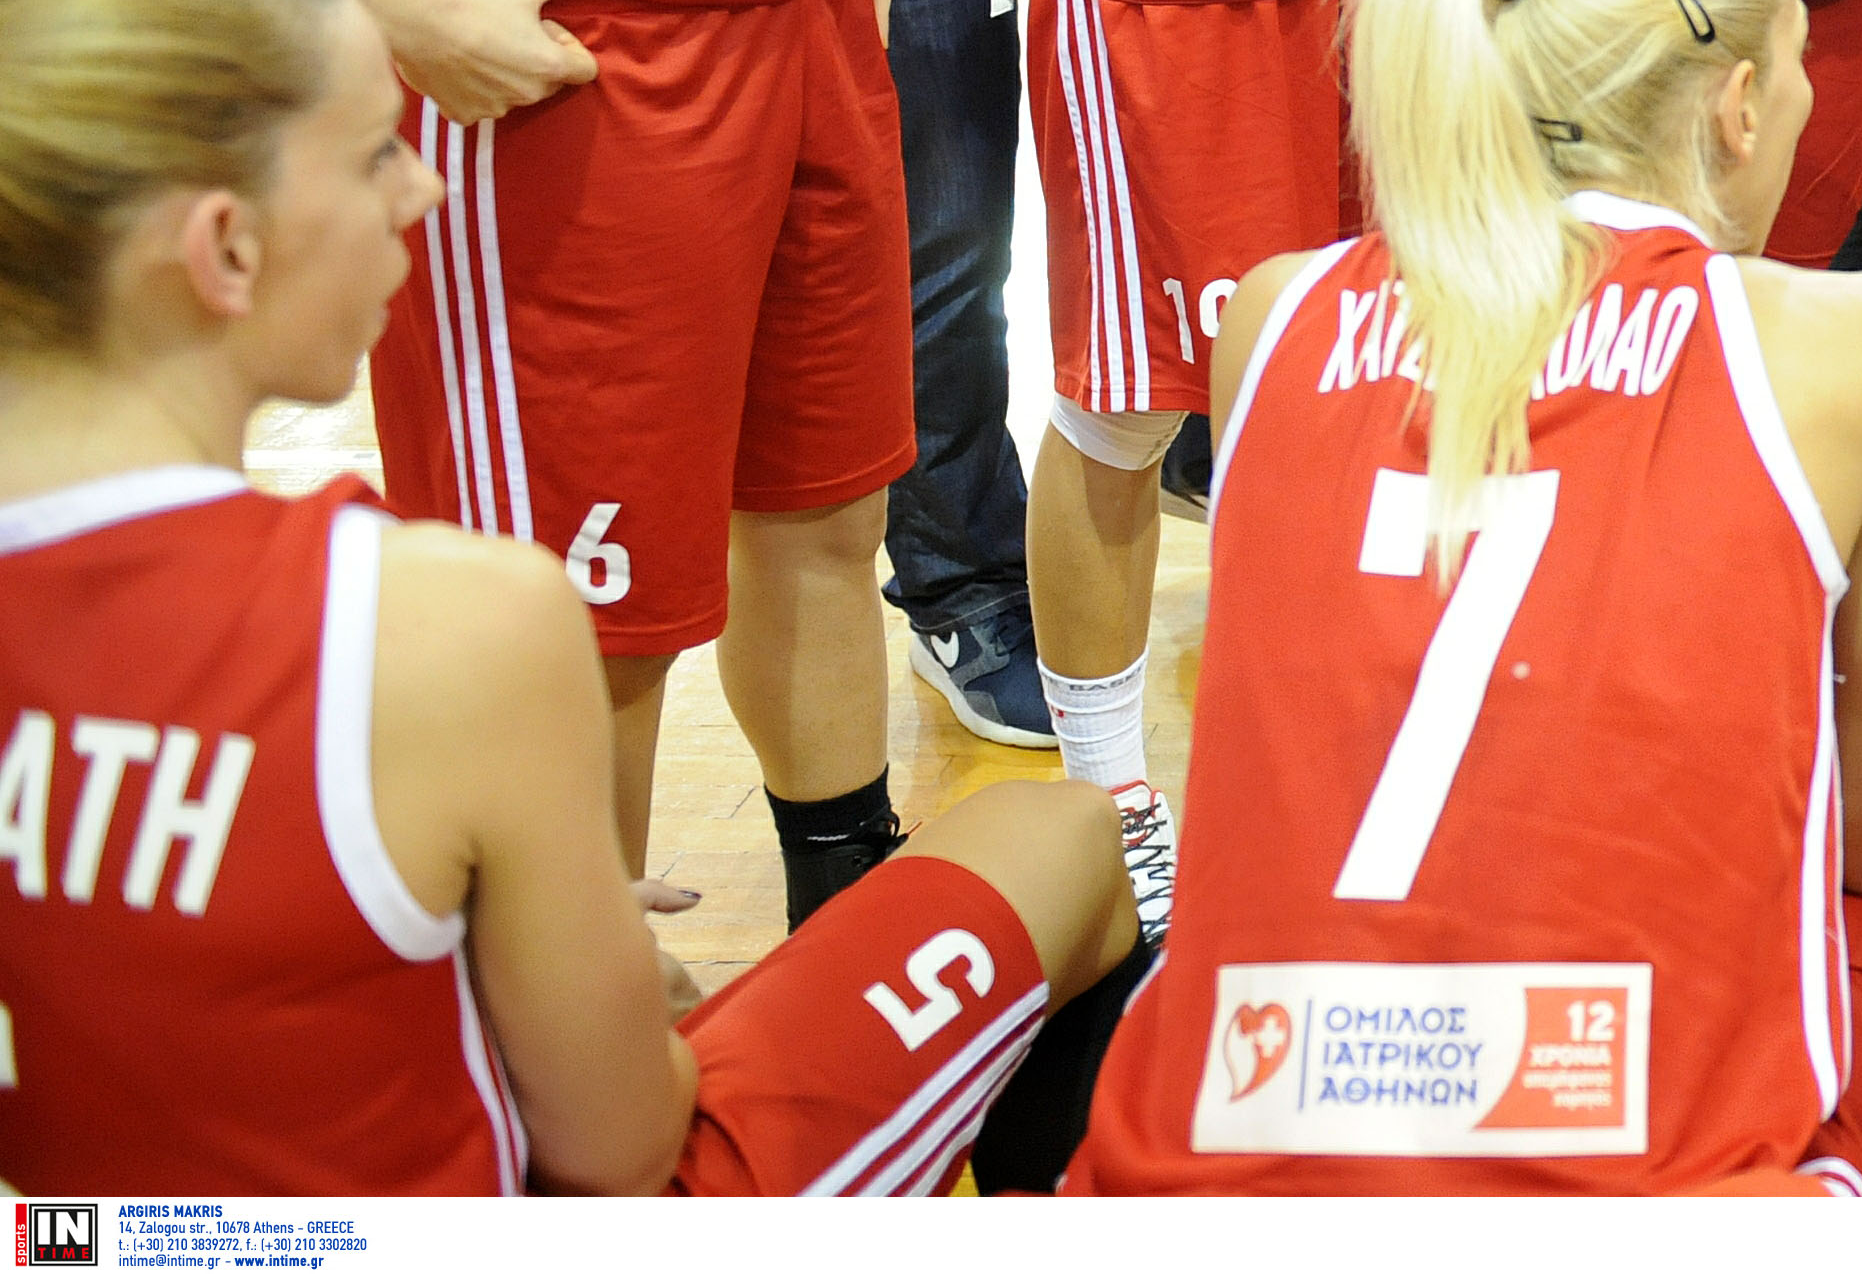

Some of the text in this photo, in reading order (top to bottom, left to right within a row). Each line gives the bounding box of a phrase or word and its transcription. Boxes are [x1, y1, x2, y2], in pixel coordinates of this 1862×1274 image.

[566, 502, 631, 605] 6
[1334, 468, 1560, 900] 7
[0, 709, 256, 917] ATH
[863, 928, 995, 1052] 5
[1325, 1005, 1466, 1034] ΟΜΙΛΟΣ
[1568, 999, 1615, 1042] 12
[1318, 1077, 1478, 1106] ΑΘΗΝΩΝ
[1323, 1042, 1483, 1071] ΙΑΤΡΙΚΟΥ
